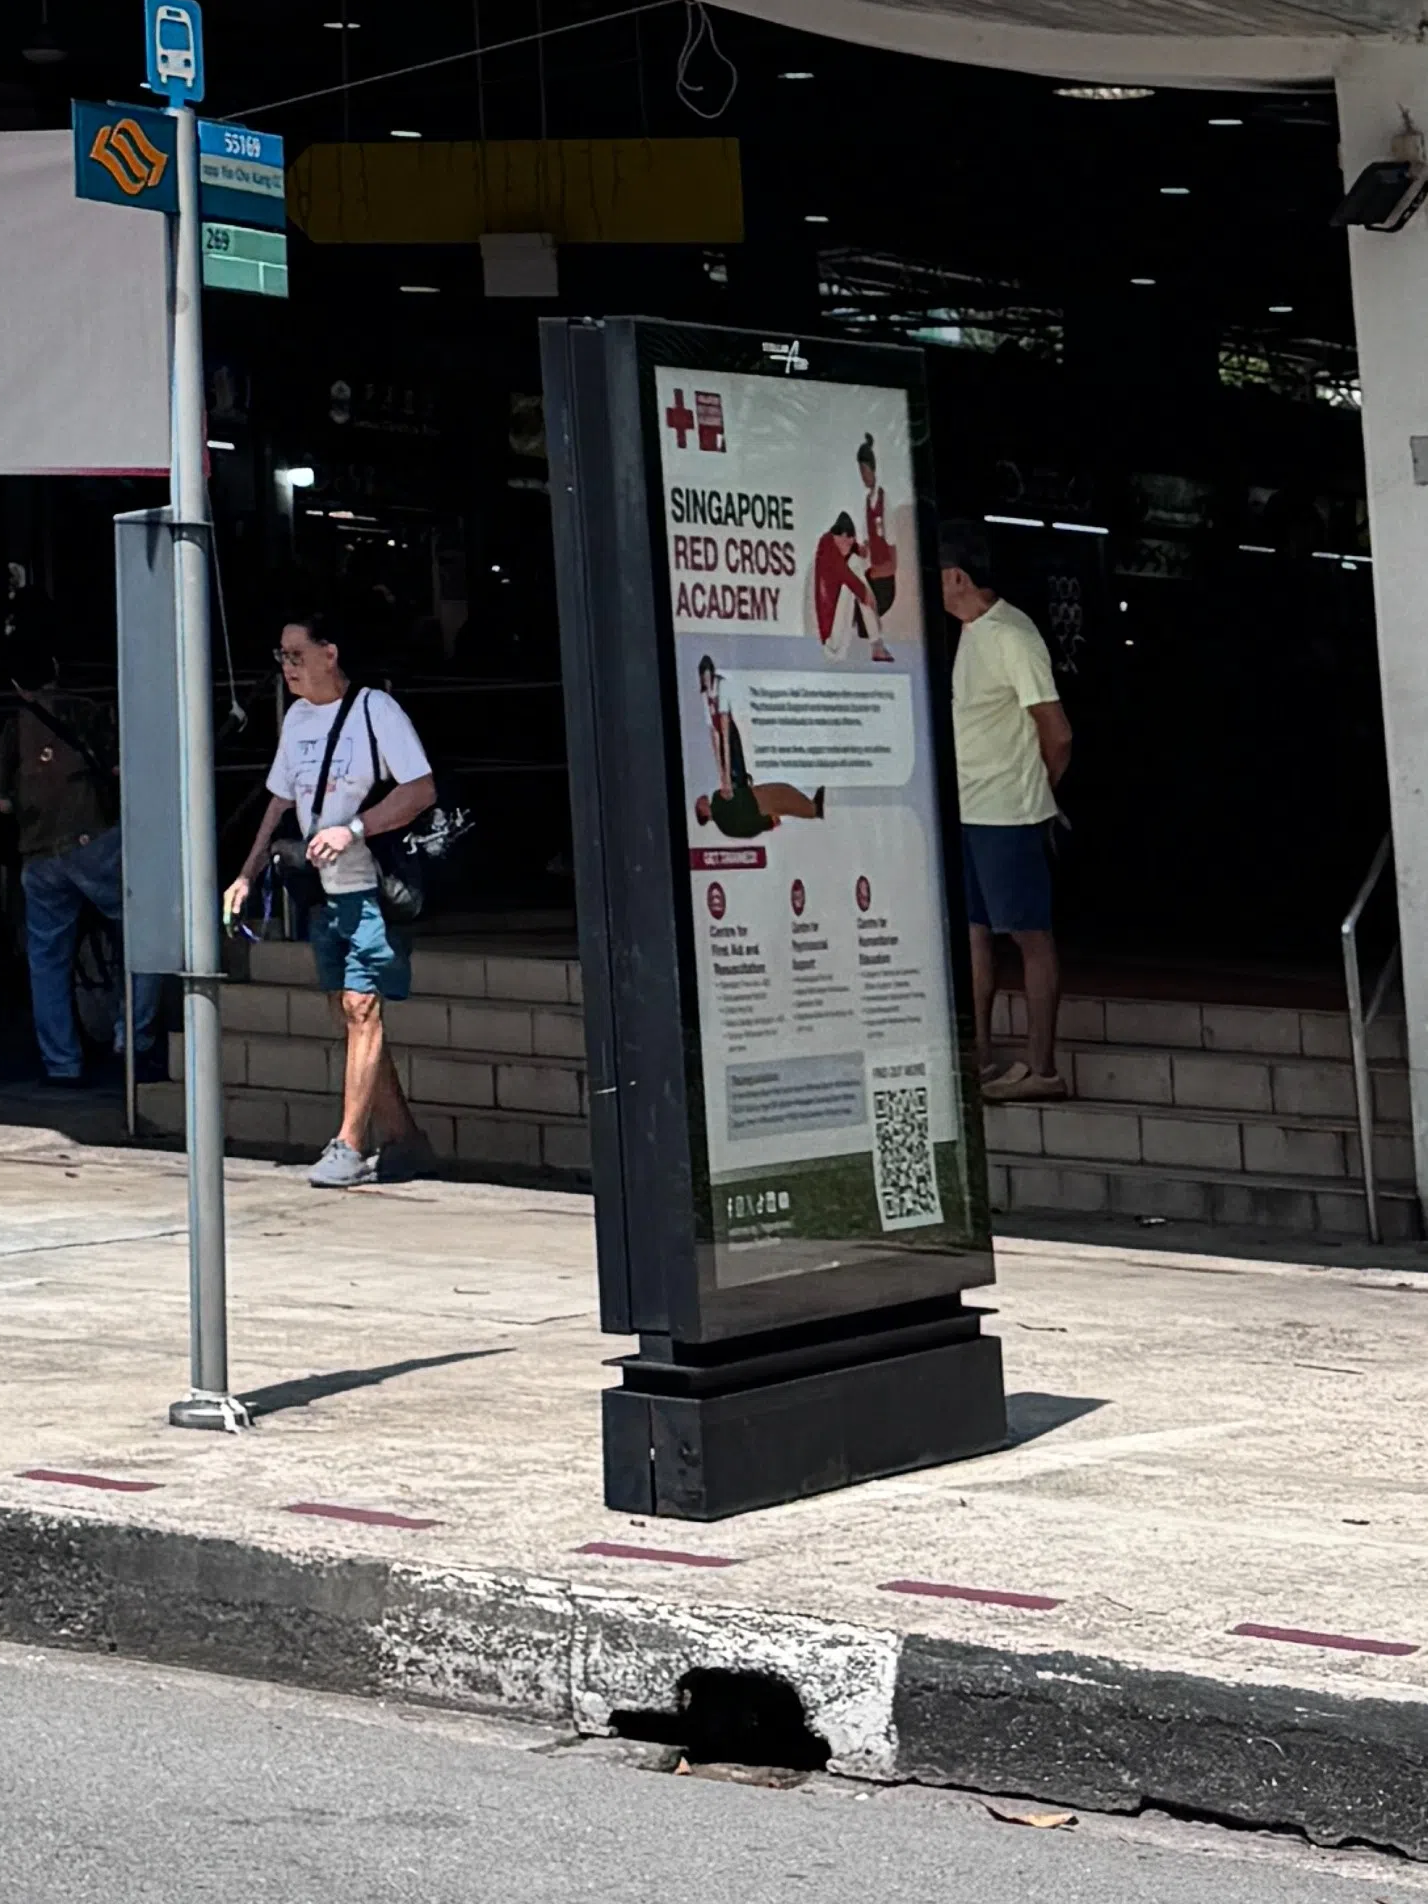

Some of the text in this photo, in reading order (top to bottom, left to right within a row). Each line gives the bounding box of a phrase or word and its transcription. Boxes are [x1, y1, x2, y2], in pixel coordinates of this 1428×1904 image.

[671, 487, 794, 531] SINGAPORE
[674, 535, 796, 575] RED CROSS
[676, 581, 781, 621] ACADEMY
